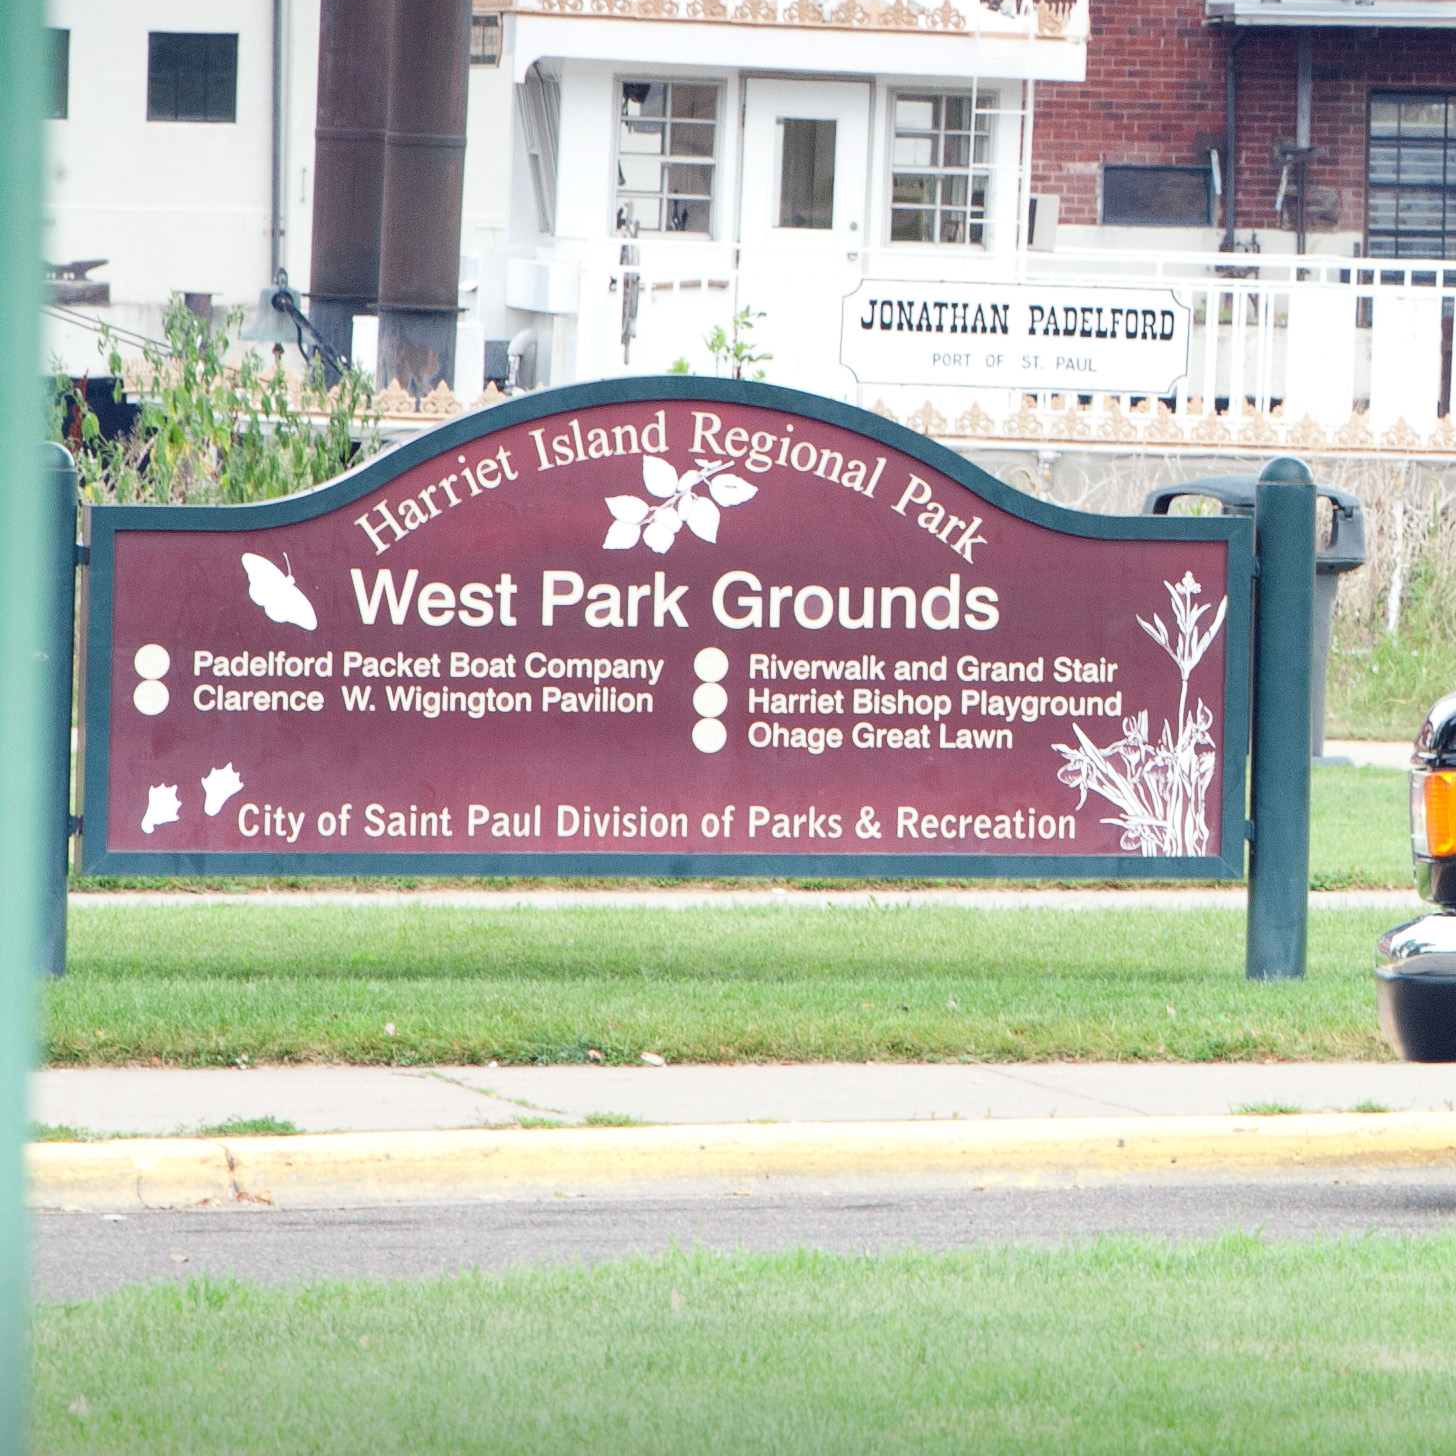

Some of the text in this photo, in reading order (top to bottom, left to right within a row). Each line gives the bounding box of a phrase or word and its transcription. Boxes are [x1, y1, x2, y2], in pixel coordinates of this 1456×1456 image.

[860, 298, 1176, 341] JONATHAN PADELFORD
[932, 352, 1098, 373] PORT OF ST. PAUL
[354, 410, 988, 564] Harriet Island Regional Park
[350, 568, 1000, 632] West Park Grounds
[193, 650, 664, 686] Padelford Packet Boat Company
[749, 654, 1118, 684] Riverwalk and Grand Stair
[193, 685, 653, 719] Clarence W. Wigington Pavilion
[748, 688, 1123, 723] Harriet Bishop Playground
[748, 722, 1013, 756] Ohage Great Lawn
[238, 802, 1077, 843] City of Saint Paul Division of Parks & Recreation
